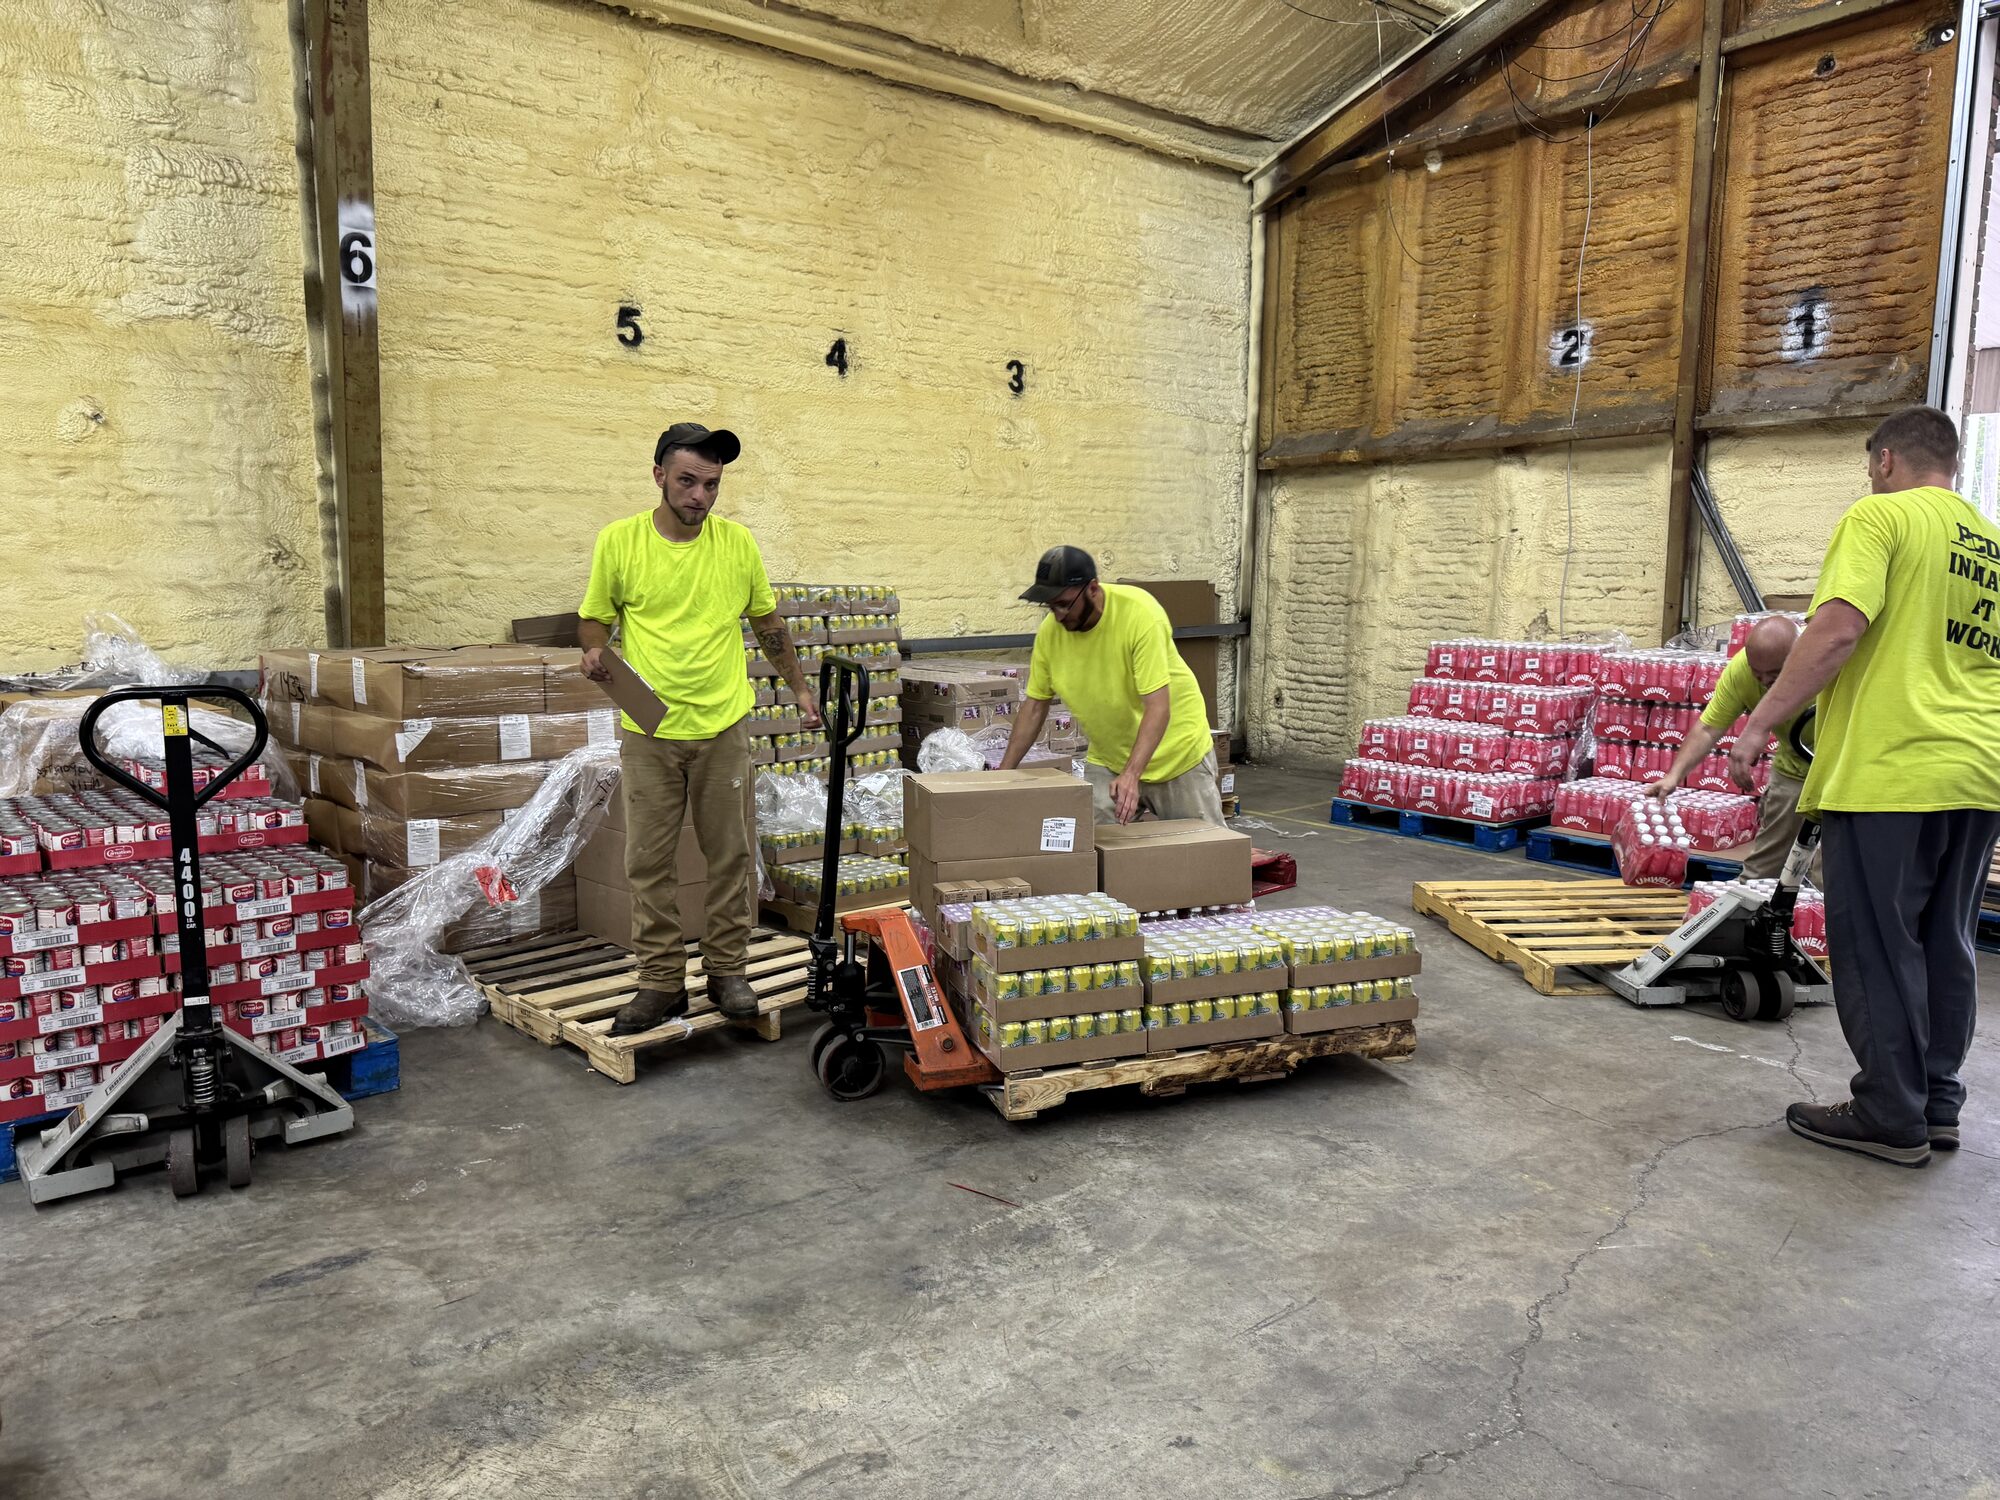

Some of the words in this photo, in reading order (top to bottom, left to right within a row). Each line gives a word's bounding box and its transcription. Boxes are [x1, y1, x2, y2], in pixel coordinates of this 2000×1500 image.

[340, 232, 373, 284] 6
[616, 306, 643, 348] 5
[1796, 301, 1816, 350] 1
[1559, 329, 1585, 366] 2
[826, 337, 848, 377] 4
[1006, 359, 1025, 394] 3
[1948, 551, 2000, 593] INMA
[1434, 666, 1456, 677] UNWELL
[1476, 669, 1498, 680] UNWELL
[1520, 672, 1544, 682] UNWELL
[1570, 674, 1596, 684] UNWELL
[1600, 682, 1626, 695] UNWELL
[1642, 686, 1671, 699] UNWELL
[1411, 704, 1433, 716] UNWELL
[1442, 707, 1466, 718] UNWELL
[1486, 712, 1505, 720] UNWE
[1514, 718, 1540, 730] UNWELL
[1604, 725, 1632, 736] UNWELL
[1658, 730, 1686, 741] UNWEL
[1368, 747, 1388, 758] UNWELL
[1408, 752, 1430, 764] UNWELL
[1452, 758, 1476, 770] UNWELL
[1510, 760, 1536, 773] UNWELL
[1598, 764, 1625, 777] UNWELL
[1643, 770, 1666, 780] UNWE
[1699, 776, 1728, 790] UNWELL
[1342, 788, 1363, 800] UNWELL
[1373, 794, 1395, 805] UNWELL
[1416, 800, 1439, 812] UNWELL
[1562, 816, 1590, 829] UNWELL
[1636, 876, 1676, 888] UNWELL
[1797, 936, 1826, 952] NWELL
